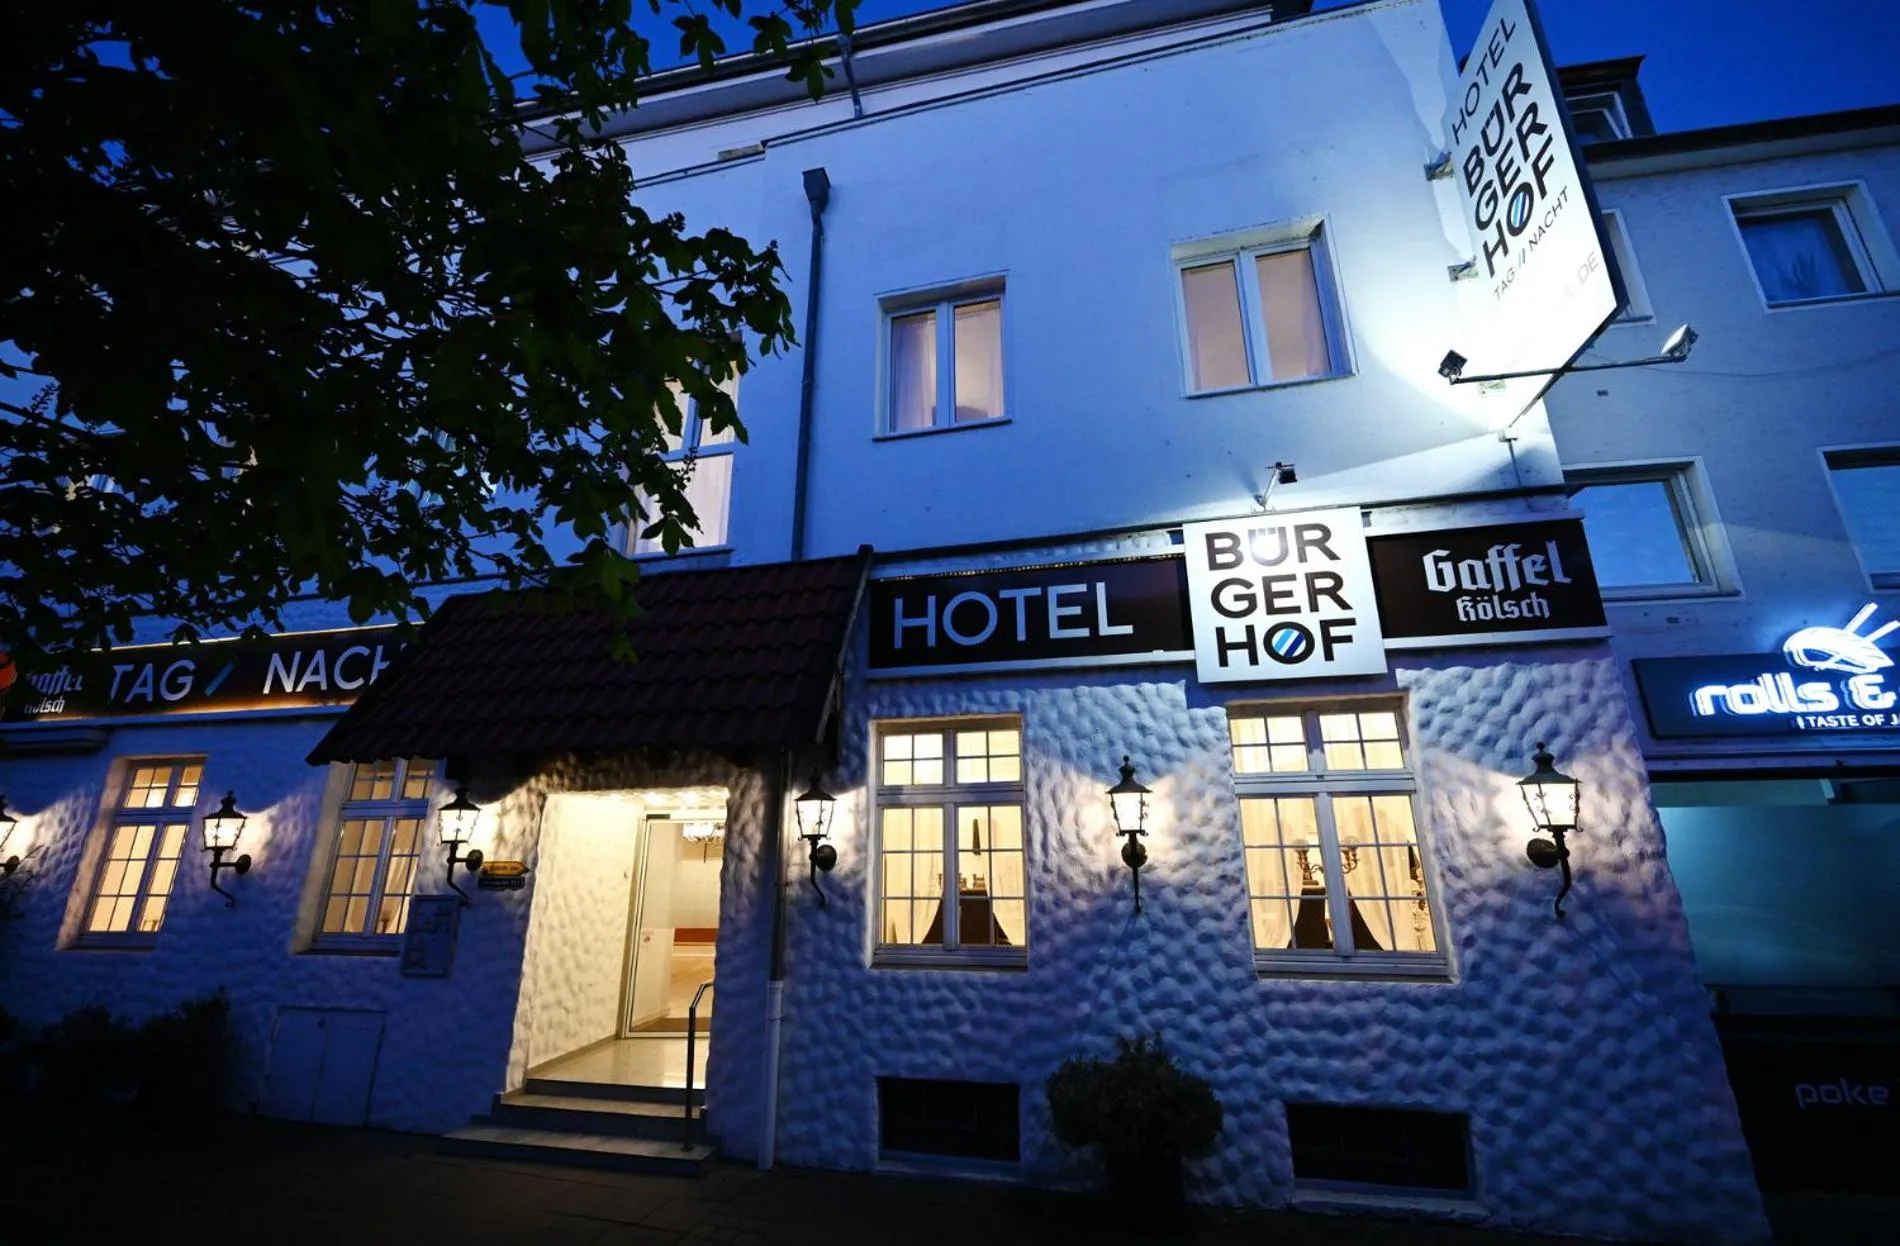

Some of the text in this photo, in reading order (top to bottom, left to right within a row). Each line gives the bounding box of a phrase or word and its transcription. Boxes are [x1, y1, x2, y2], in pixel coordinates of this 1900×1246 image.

[1452, 17, 1516, 145] HOTEL
[1463, 62, 1532, 198] BÜR
[1475, 101, 1548, 231] GER
[1482, 133, 1554, 278] HOF
[1494, 267, 1515, 300] TAG
[1528, 185, 1568, 252] NACHT
[1205, 522, 1341, 571] BÜR
[1422, 540, 1573, 593] Gaffel
[894, 581, 1134, 649] HOTEL
[1210, 570, 1353, 618] GER
[1456, 591, 1550, 622] Kölsch
[1215, 617, 1357, 668] HOF
[25, 664, 84, 696] affel
[109, 658, 197, 704] TAG
[1690, 672, 1897, 717] rolls &
[24, 695, 66, 715] lsch
[1806, 714, 1900, 728] TASTE OF J
[1793, 1075, 1890, 1110] poke
